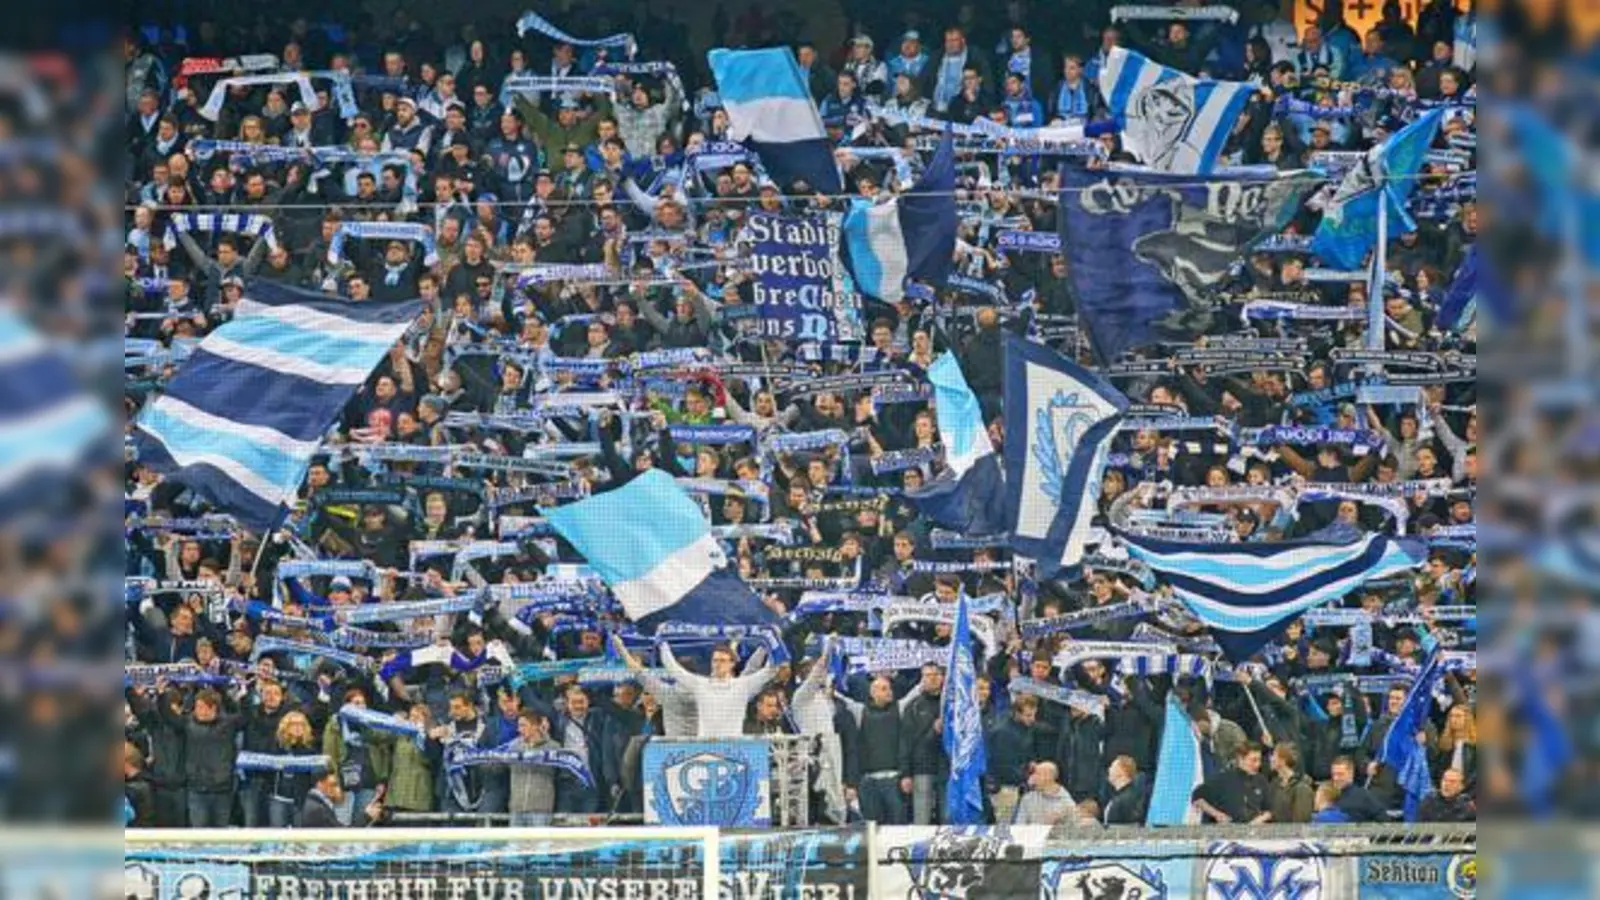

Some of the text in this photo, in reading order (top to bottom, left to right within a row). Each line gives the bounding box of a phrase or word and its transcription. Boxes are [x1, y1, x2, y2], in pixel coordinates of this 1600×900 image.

[1368, 859, 1438, 883] Sektion
[253, 874, 437, 900] FREIHEIT
[446, 870, 525, 900] FÜR
[538, 876, 698, 900] UNSERE
